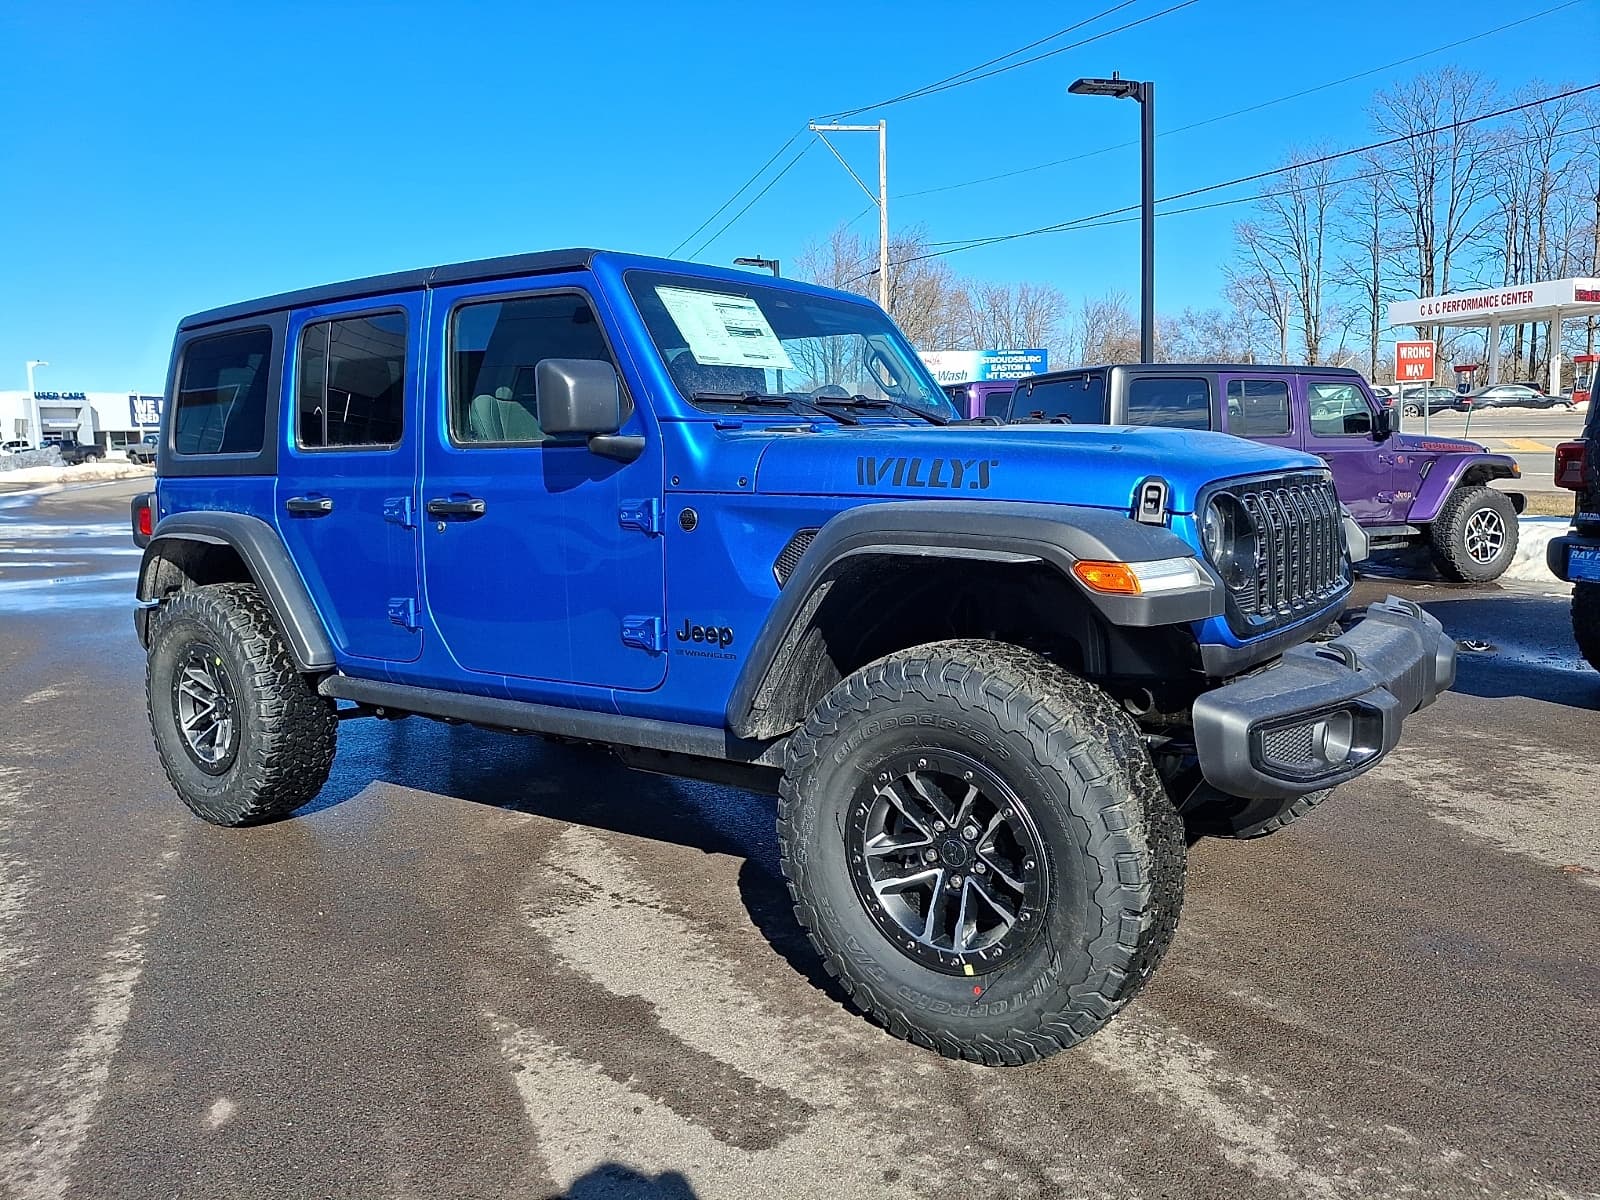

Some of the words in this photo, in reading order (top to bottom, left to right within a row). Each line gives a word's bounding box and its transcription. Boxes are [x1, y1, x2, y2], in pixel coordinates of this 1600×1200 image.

[1420, 304, 1426, 316] C
[1427, 303, 1433, 315] &
[1435, 302, 1440, 314] C
[1442, 294, 1499, 313] PERFORMANCE
[1501, 290, 1534, 306] CENTER
[1400, 346, 1431, 359] WRONG
[982, 355, 1041, 363] STROUDSBURG
[937, 370, 968, 381] Wash
[1405, 363, 1425, 377] WAY
[34, 391, 59, 400] USED
[62, 392, 86, 400] CARS
[134, 399, 155, 413] WE
[134, 413, 160, 424] USED
[856, 456, 999, 490] WILLYS
[1394, 490, 1411, 500] Jeep
[1570, 550, 1591, 561] RAY
[676, 618, 734, 650] Jeep
[685, 649, 737, 661] WRANGLER
